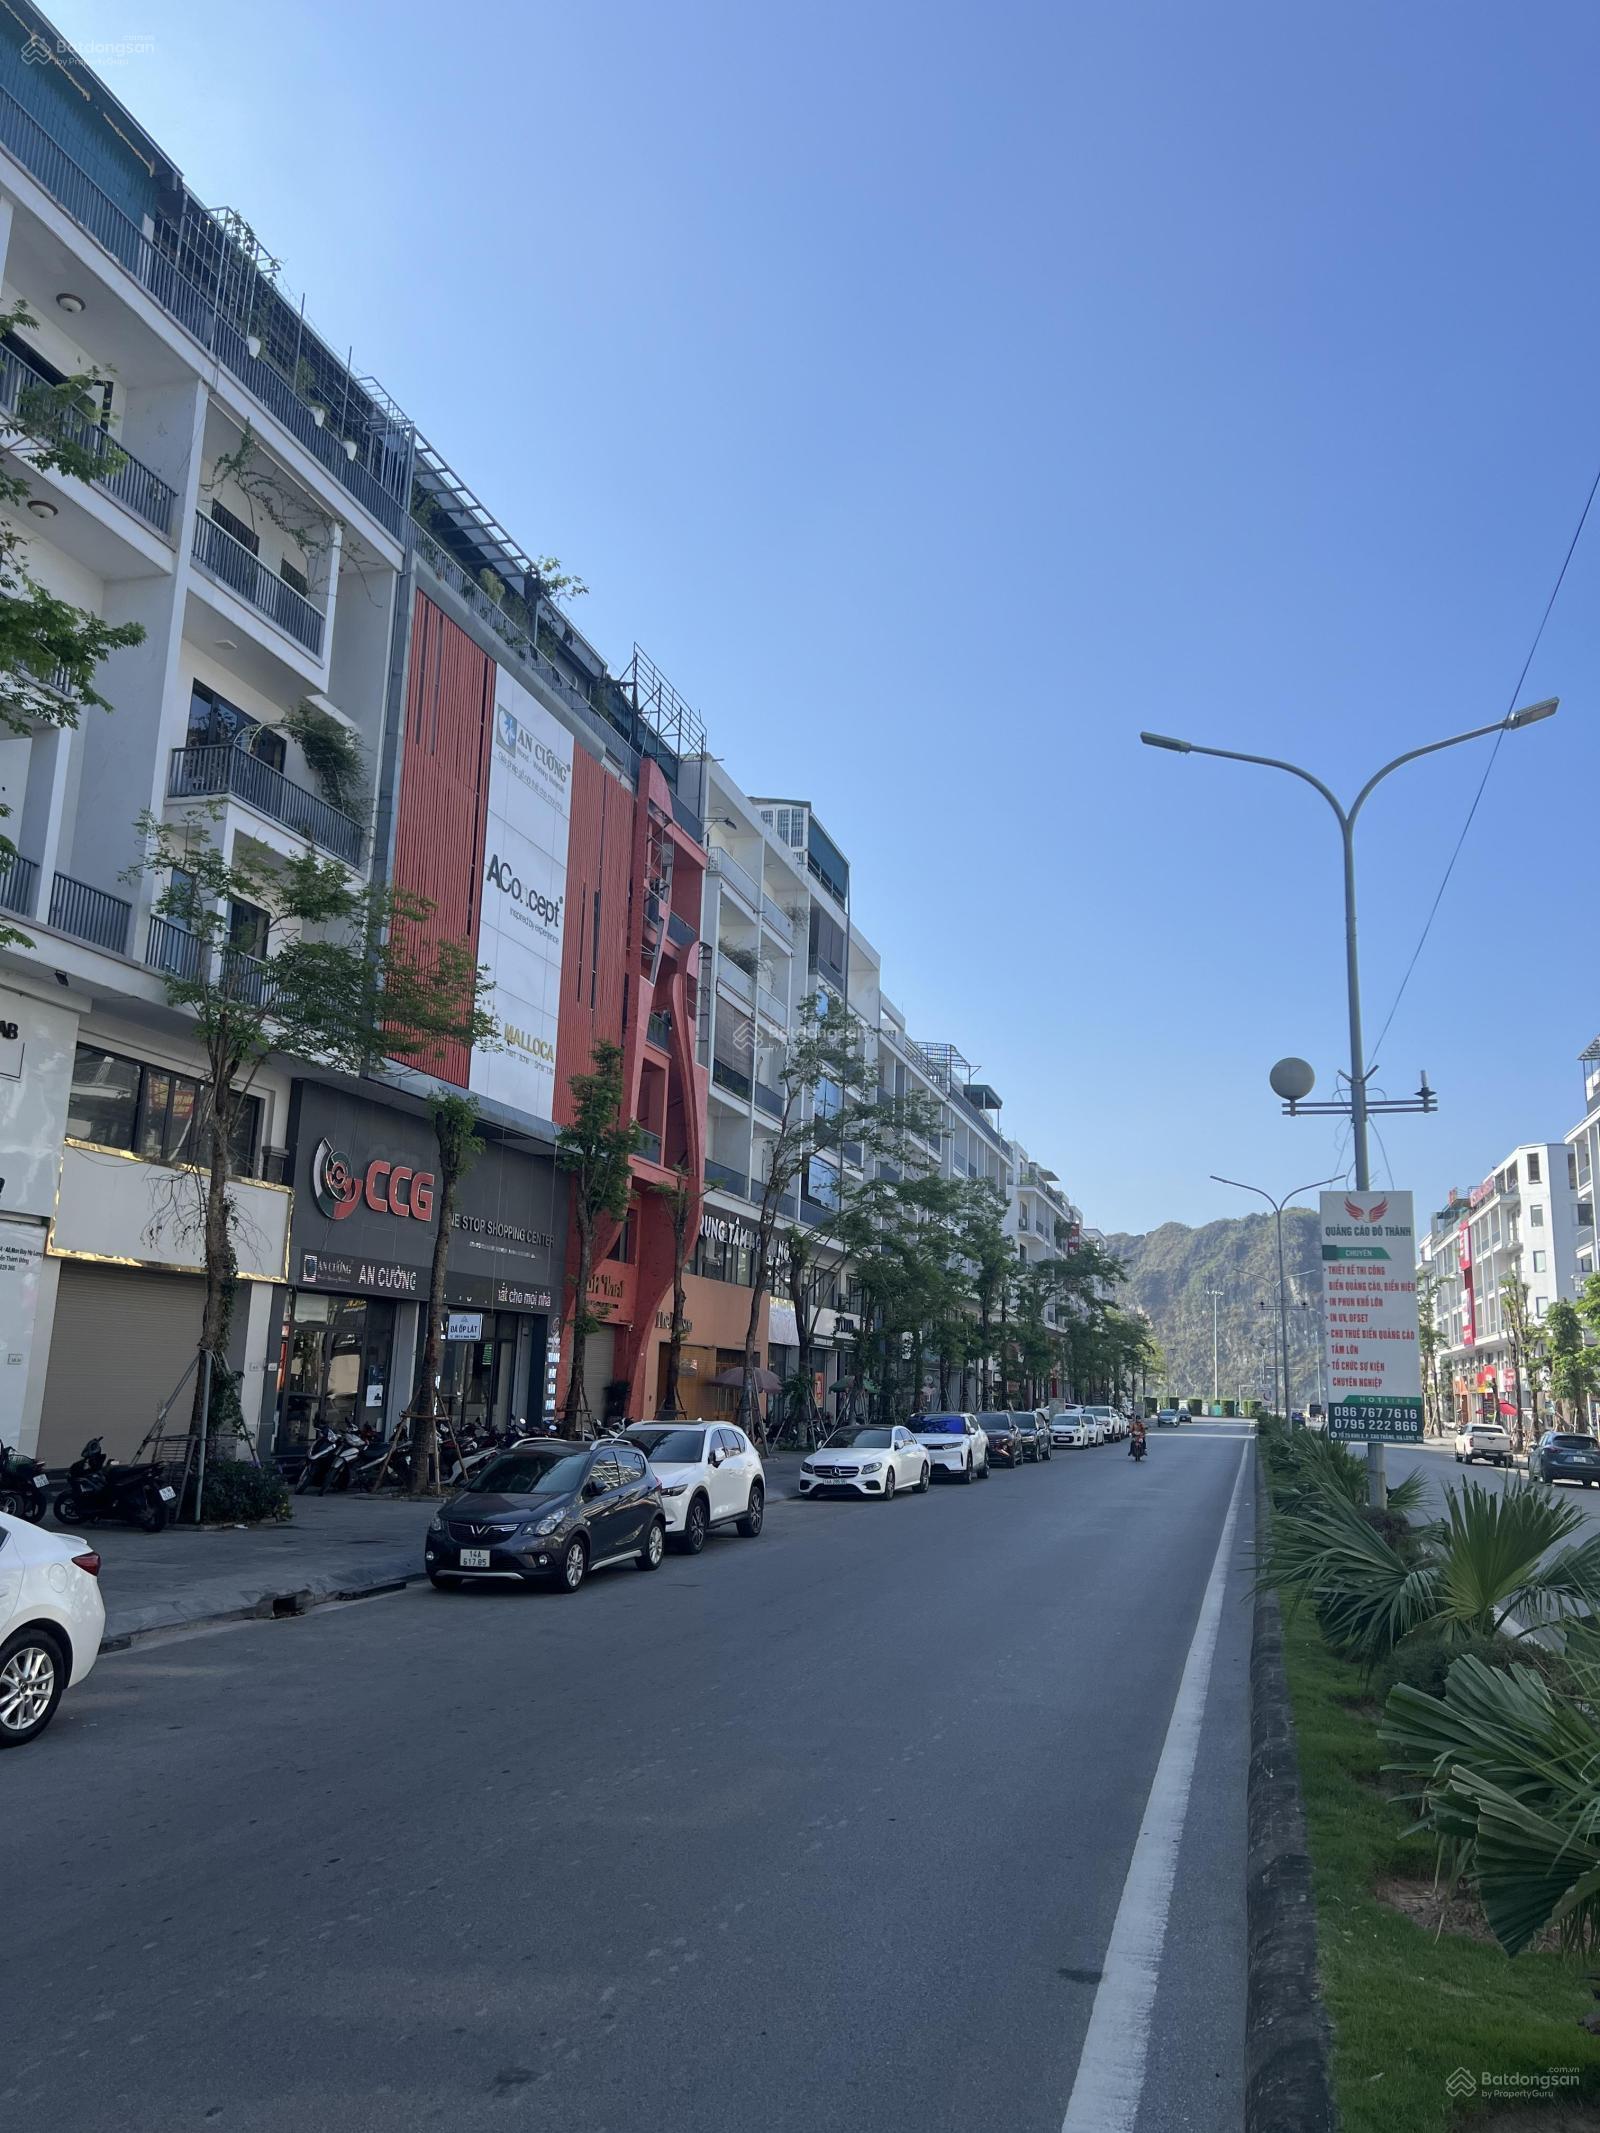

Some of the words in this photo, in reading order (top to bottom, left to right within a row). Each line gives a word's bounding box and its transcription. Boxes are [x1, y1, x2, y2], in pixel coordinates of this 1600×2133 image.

[518, 728, 533, 753] AN
[486, 854, 560, 928] ACocept
[504, 1022, 554, 1064] MALLOCA
[366, 1159, 435, 1222] CCG
[462, 1215, 486, 1233] STOP
[487, 1220, 526, 1242] SHOPPING
[526, 1229, 554, 1249] CENTER
[699, 1214, 727, 1243] RUNG
[728, 1216, 750, 1249] TÂM
[1325, 1223, 1353, 1237] QUẢNG
[1354, 1223, 1371, 1237] CÁO
[1385, 1224, 1412, 1237] THÀNH
[358, 1264, 376, 1286] AN
[1328, 1264, 1346, 1275] THIẾT
[1356, 1266, 1367, 1275] THI
[1368, 1265, 1386, 1276] CÔNG
[1345, 1279, 1367, 1291] QUẢNG
[509, 1288, 523, 1303] cho
[1329, 1298, 1337, 1307] IN
[1338, 1298, 1356, 1307] PHUN
[1330, 1313, 1337, 1322] IN
[1349, 1313, 1368, 1323] OFSET
[1331, 1329, 1344, 1338] CHO
[1378, 1328, 1401, 1340] QUẢNG
[1402, 1329, 1415, 1340] CÁO
[1334, 1406, 1357, 1417] 086
[1361, 1407, 1383, 1418] 767
[1386, 1408, 1418, 1420] 7616
[1334, 1418, 1366, 1430] 0795
[1368, 1419, 1392, 1431] 222
[1395, 1420, 1418, 1432] 866
